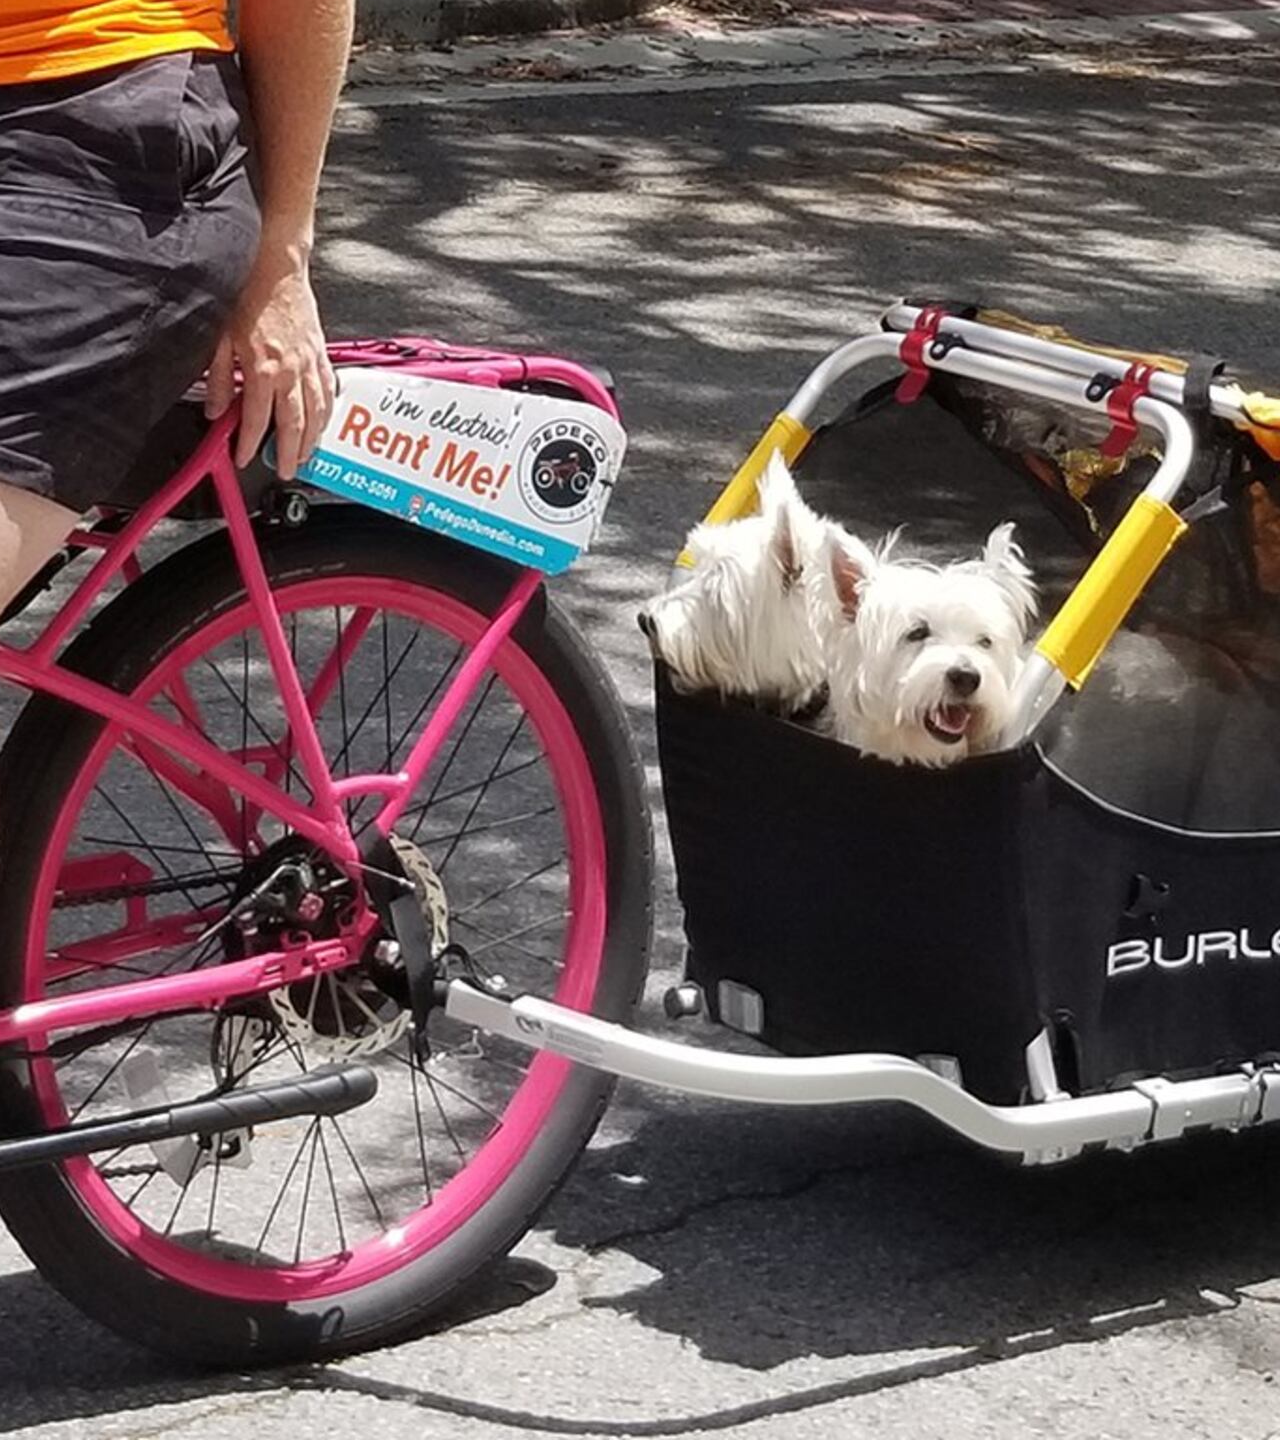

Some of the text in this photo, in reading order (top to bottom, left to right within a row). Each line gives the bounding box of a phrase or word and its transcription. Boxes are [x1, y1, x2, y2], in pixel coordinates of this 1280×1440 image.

[337, 404, 431, 472] Rent
[433, 441, 512, 501] Me!
[530, 424, 606, 463] PEDEGO
